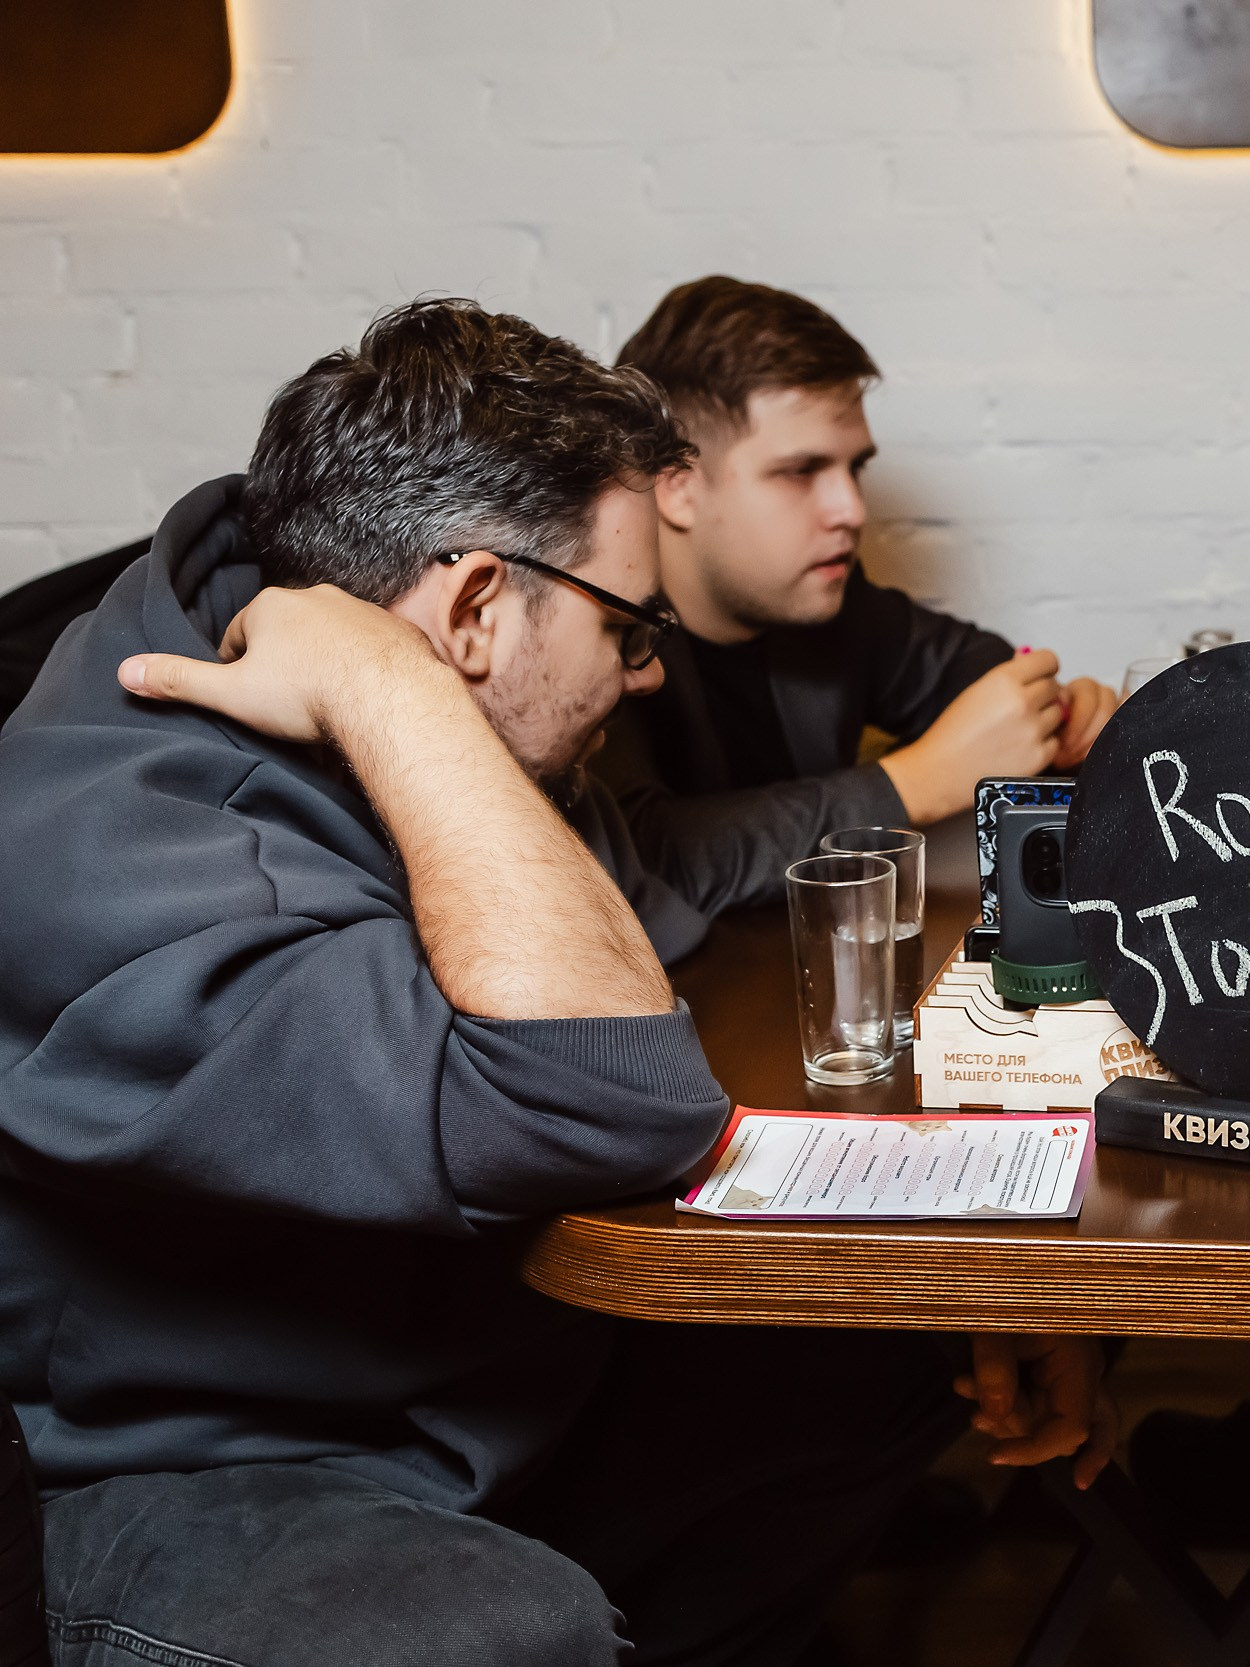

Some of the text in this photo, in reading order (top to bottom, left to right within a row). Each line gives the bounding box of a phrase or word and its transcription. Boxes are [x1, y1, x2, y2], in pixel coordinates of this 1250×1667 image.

[944, 1053, 1026, 1067] МЕСТО ДЛЯ
[1101, 1040, 1151, 1066] КВИ
[944, 1070, 1083, 1085] ВАШЕГО ТЕЛЕФОНА
